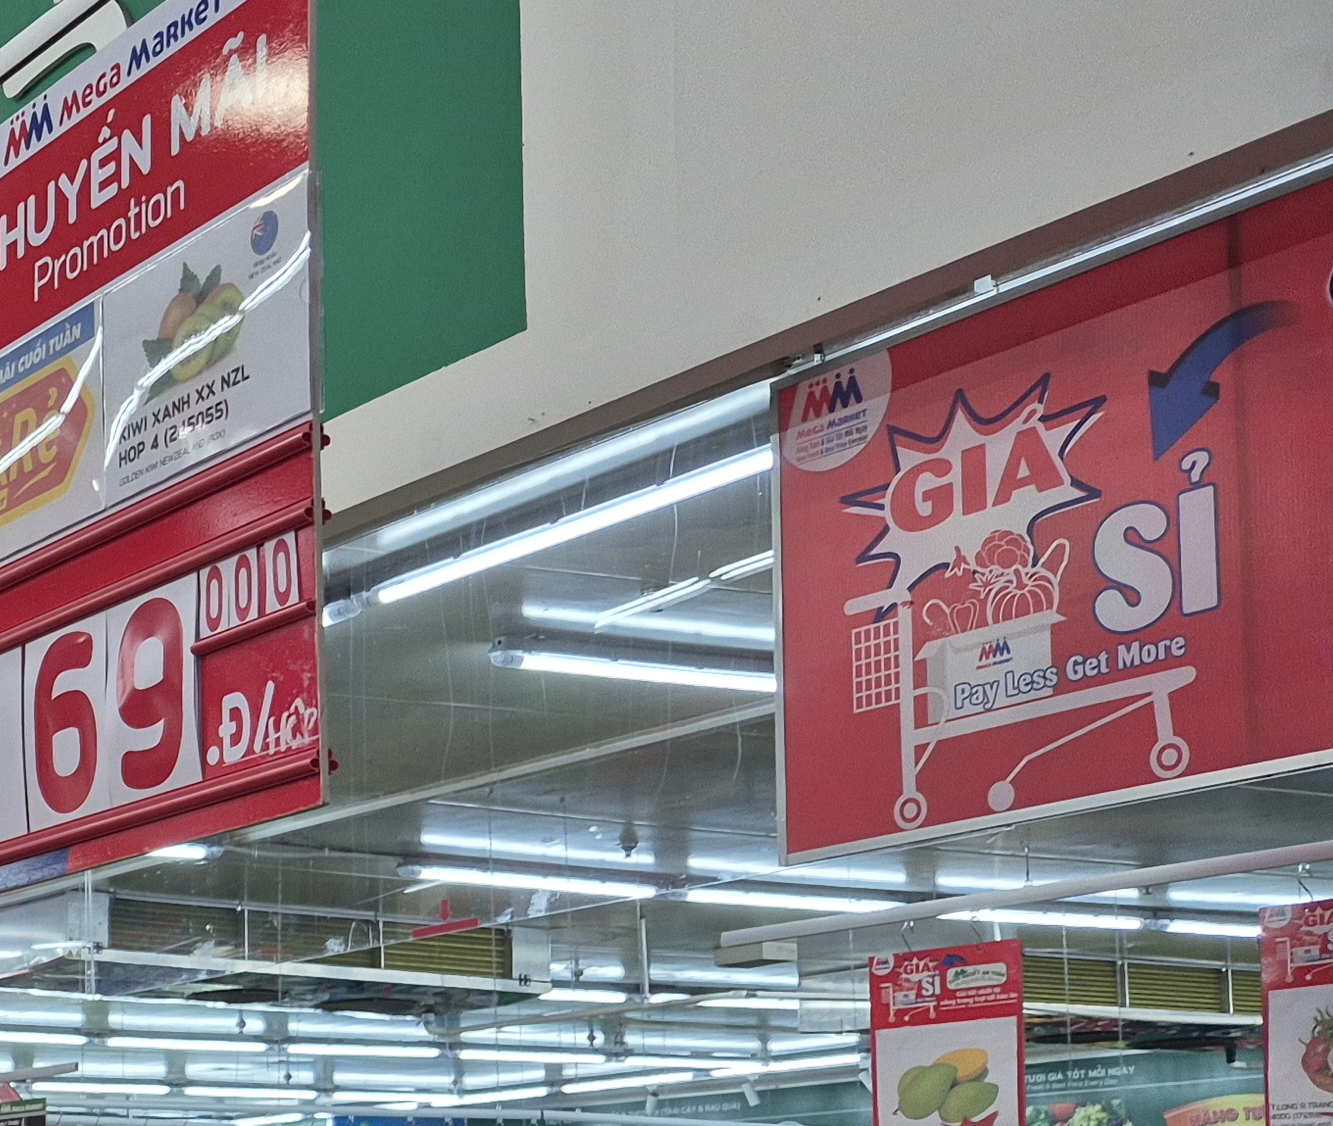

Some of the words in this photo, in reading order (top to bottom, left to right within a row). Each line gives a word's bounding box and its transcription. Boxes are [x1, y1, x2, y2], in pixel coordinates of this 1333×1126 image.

[170, 31, 269, 156] MÃI
[34, 178, 186, 302] Promotion
[118, 417, 148, 445] KIWI
[151, 392, 191, 426] XANH
[195, 379, 217, 403] XX
[220, 364, 251, 392] NZL
[150, 433, 160, 450] 4
[888, 401, 1066, 533] GIÁ
[1093, 448, 1221, 633] SỈ
[34, 597, 185, 814] 69
[204, 536, 293, 633] 000
[953, 676, 1000, 711] Pay
[1004, 664, 1059, 699] Less
[1065, 653, 1110, 682] Get
[1115, 633, 1187, 670] More
